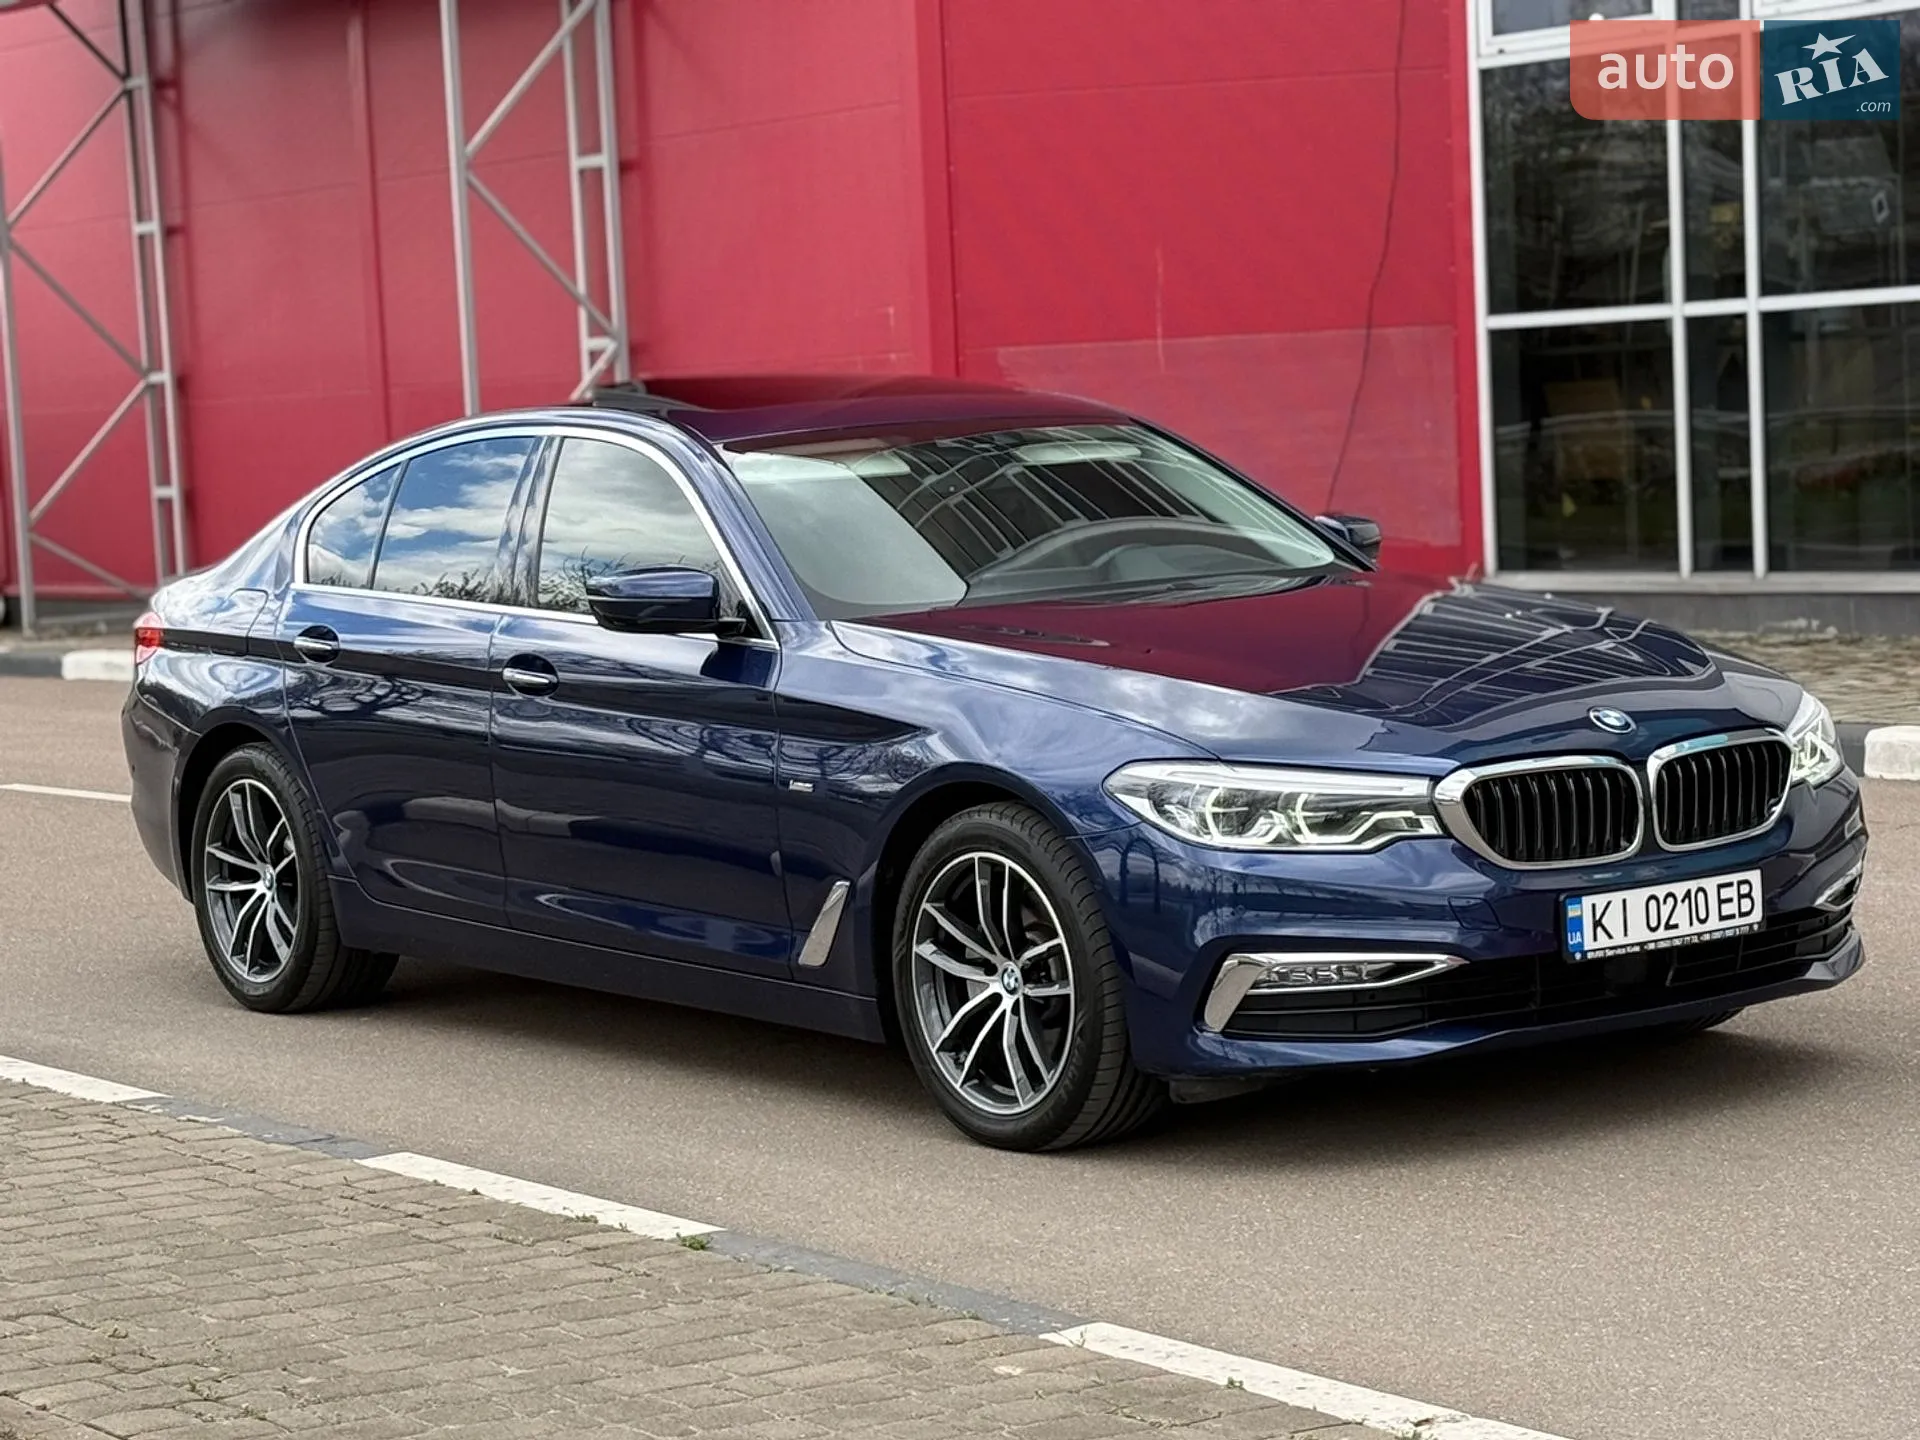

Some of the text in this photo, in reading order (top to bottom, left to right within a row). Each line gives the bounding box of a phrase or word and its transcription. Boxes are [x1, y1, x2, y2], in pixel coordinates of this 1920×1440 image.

[1591, 879, 1755, 942] KI 0210 EB
[1567, 931, 1583, 945] UA
